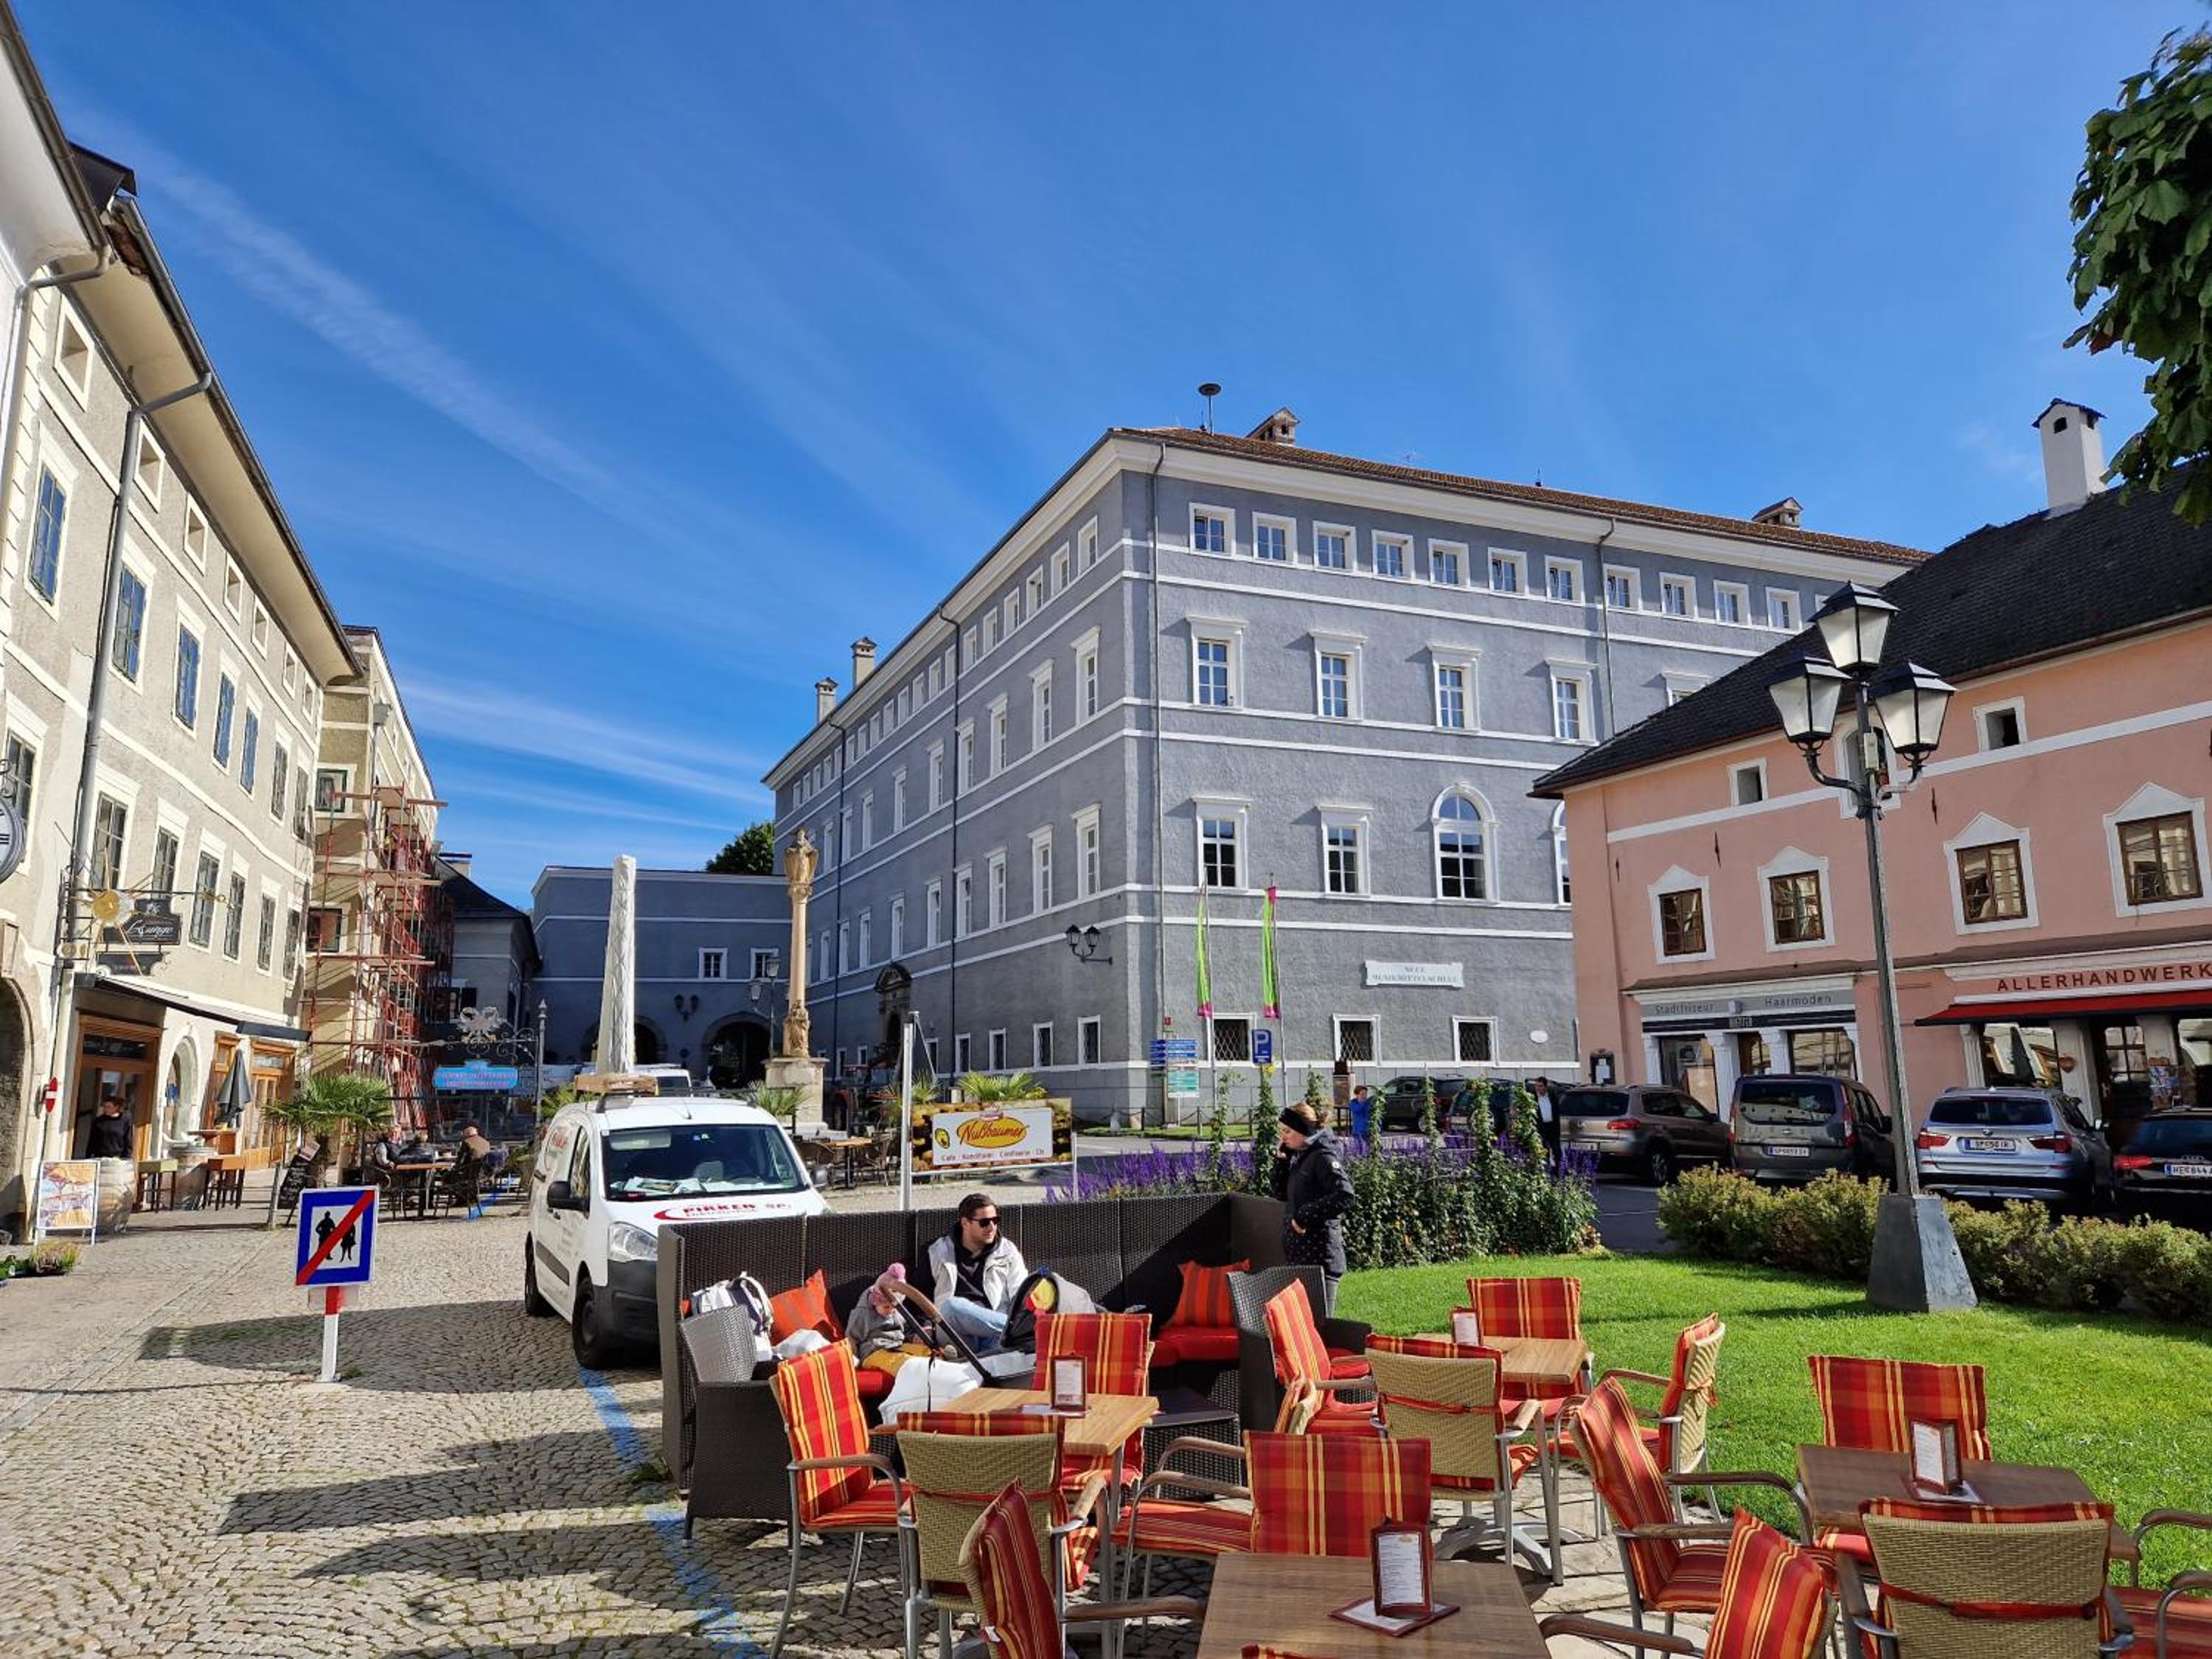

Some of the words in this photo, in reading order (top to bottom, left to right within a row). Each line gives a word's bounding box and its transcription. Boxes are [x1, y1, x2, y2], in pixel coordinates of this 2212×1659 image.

[1997, 963, 2212, 992] ALLERHANDWERK
[1764, 995, 1832, 1007] Haarmoden
[1255, 1031, 1269, 1054] P
